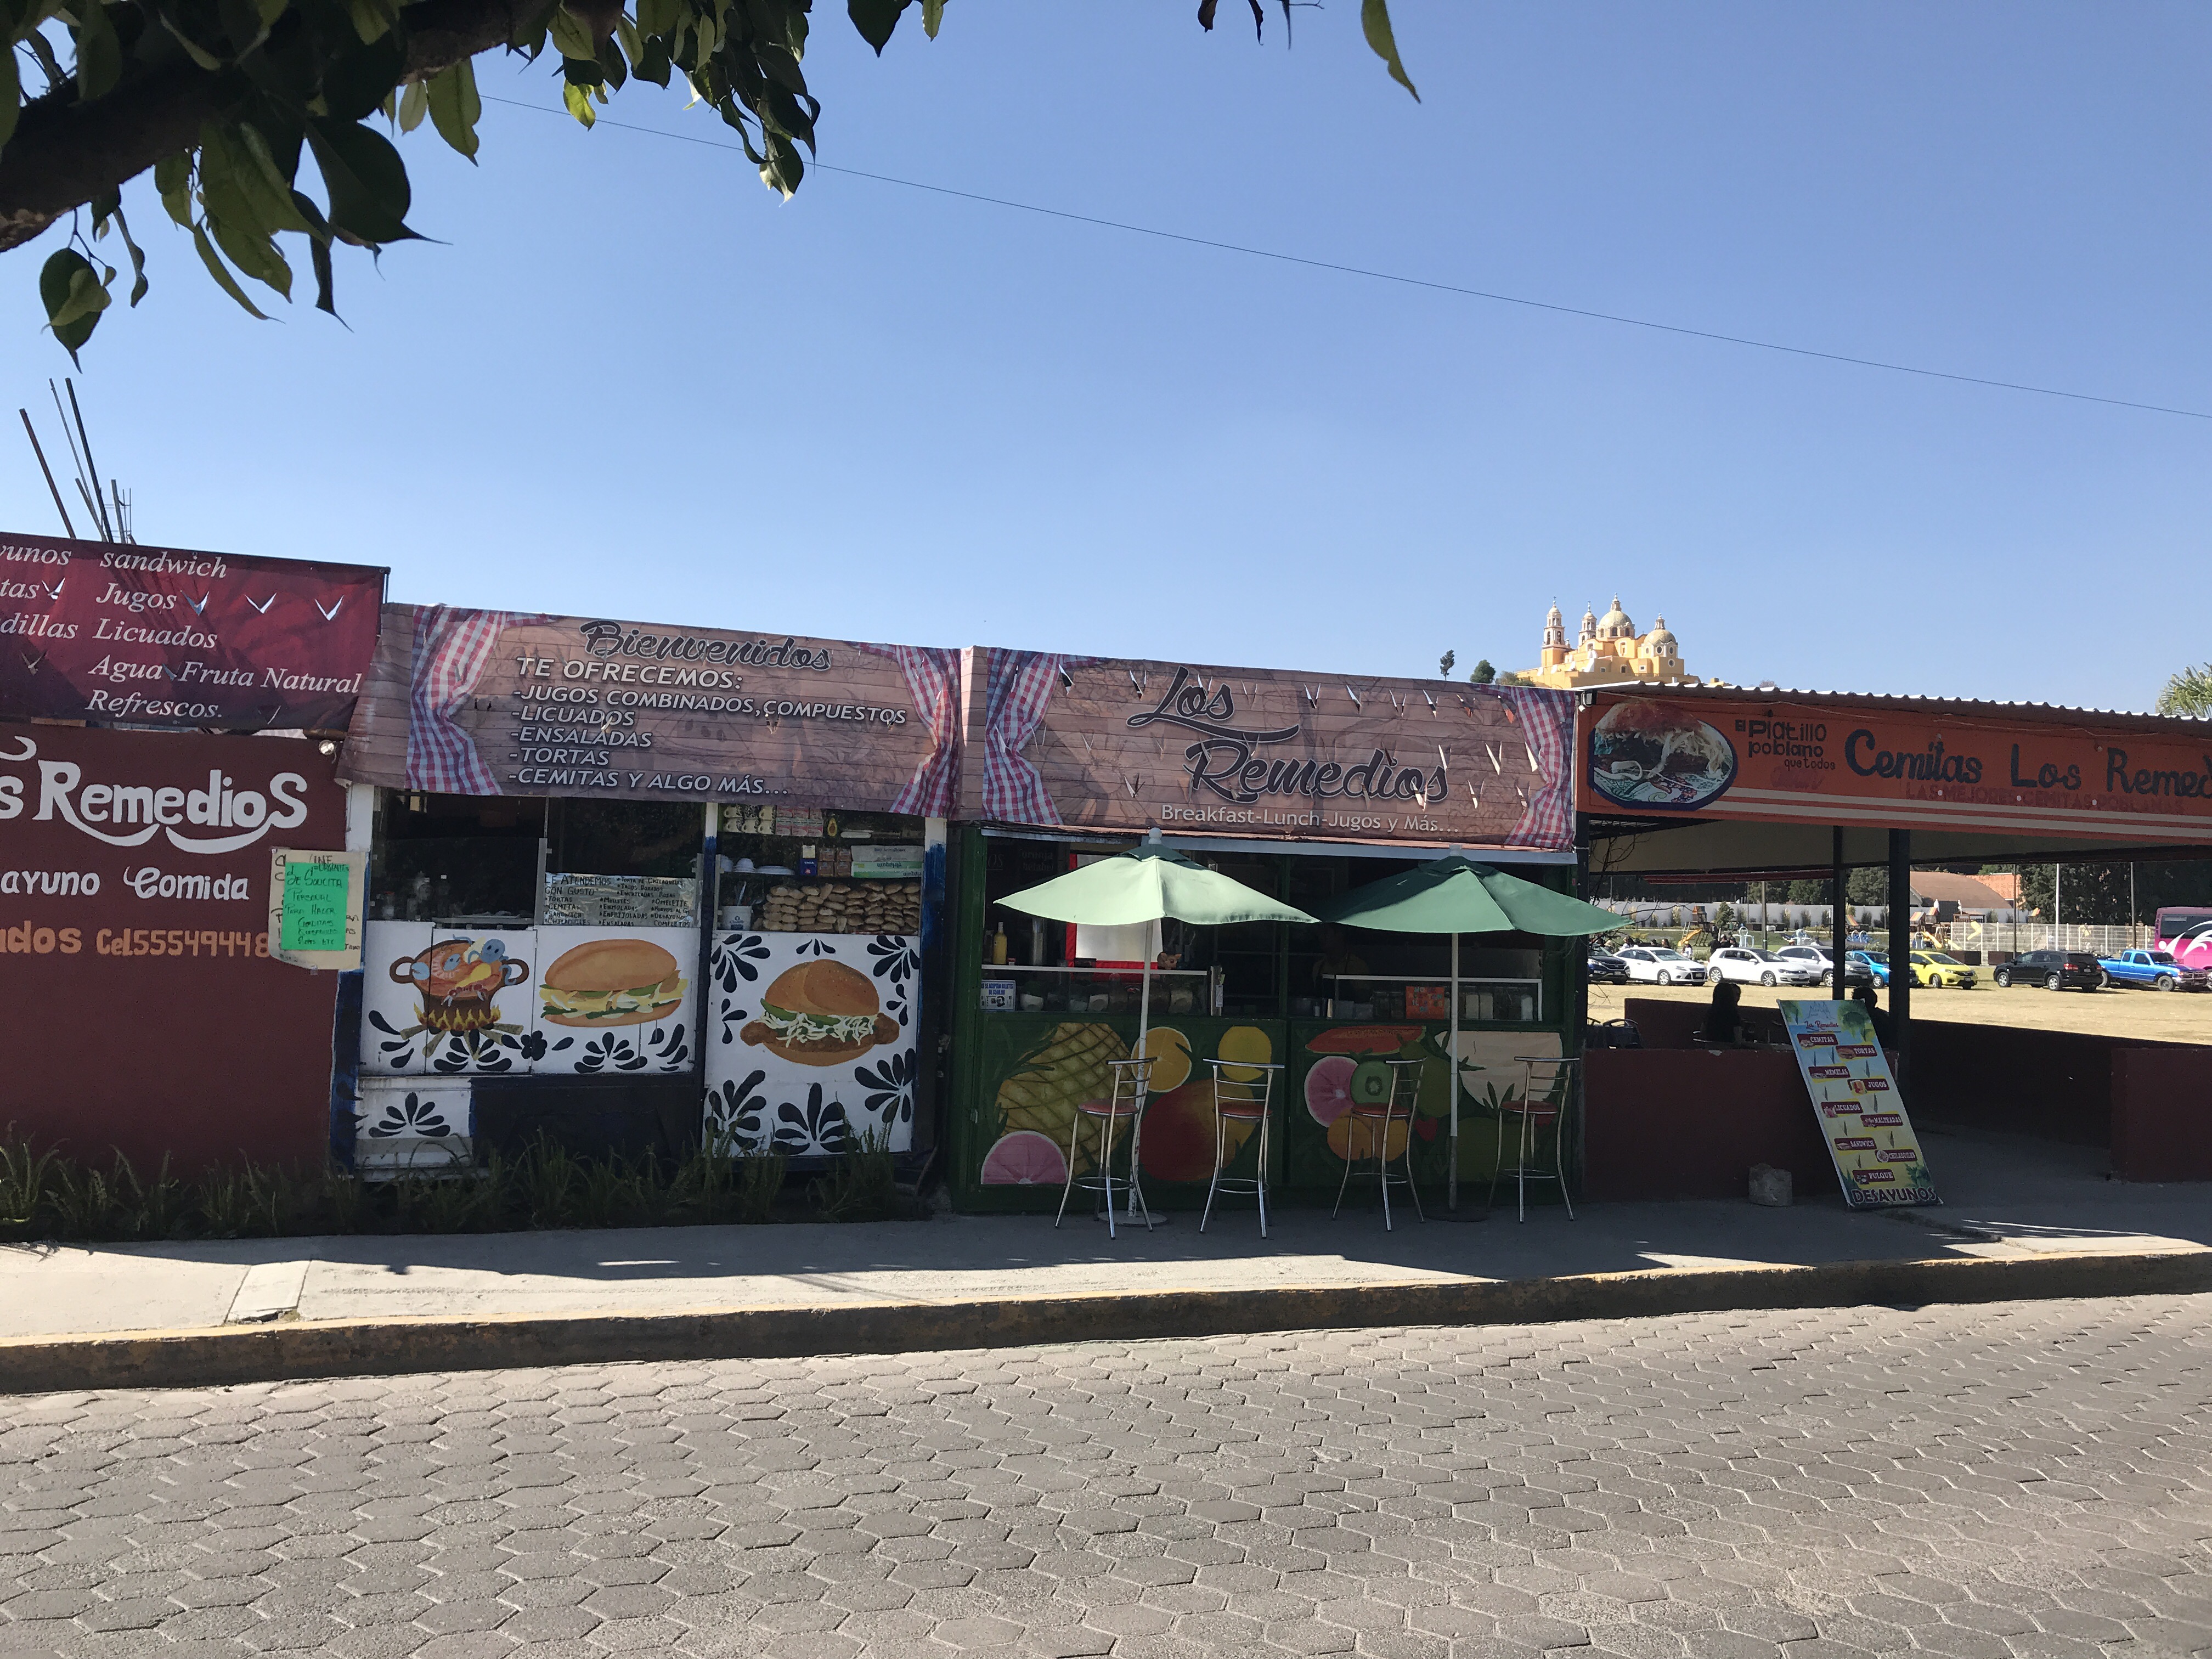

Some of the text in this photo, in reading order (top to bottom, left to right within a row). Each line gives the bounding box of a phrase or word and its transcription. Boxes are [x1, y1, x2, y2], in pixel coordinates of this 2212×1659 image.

[100, 551, 228, 578] sandwich
[0, 579, 177, 612] tas Jugos
[0, 612, 218, 648] dillas Licuados
[579, 620, 832, 672] Bienvenidos
[88, 654, 363, 694] Agua Fruta Natural
[517, 657, 743, 690] TE OFRECEMOS:
[85, 689, 222, 719] Refrescos.
[1748, 720, 1827, 742] Platillo
[1748, 740, 1824, 758] poblano
[1844, 729, 1983, 785] Cemitas
[2010, 743, 2081, 790] Los
[628, 772, 644, 788] Y
[647, 774, 712, 791] ALGO
[1183, 737, 1449, 804] Remedios
[1387, 816, 1398, 833] y
[123, 866, 250, 900] Comida
[545, 873, 612, 885] LE ATENDEMOS
[545, 886, 595, 896] CON GUSTO
[1850, 1139, 1875, 1148] SANDWICH
[1851, 1187, 1937, 1204] DESAYUNOS
